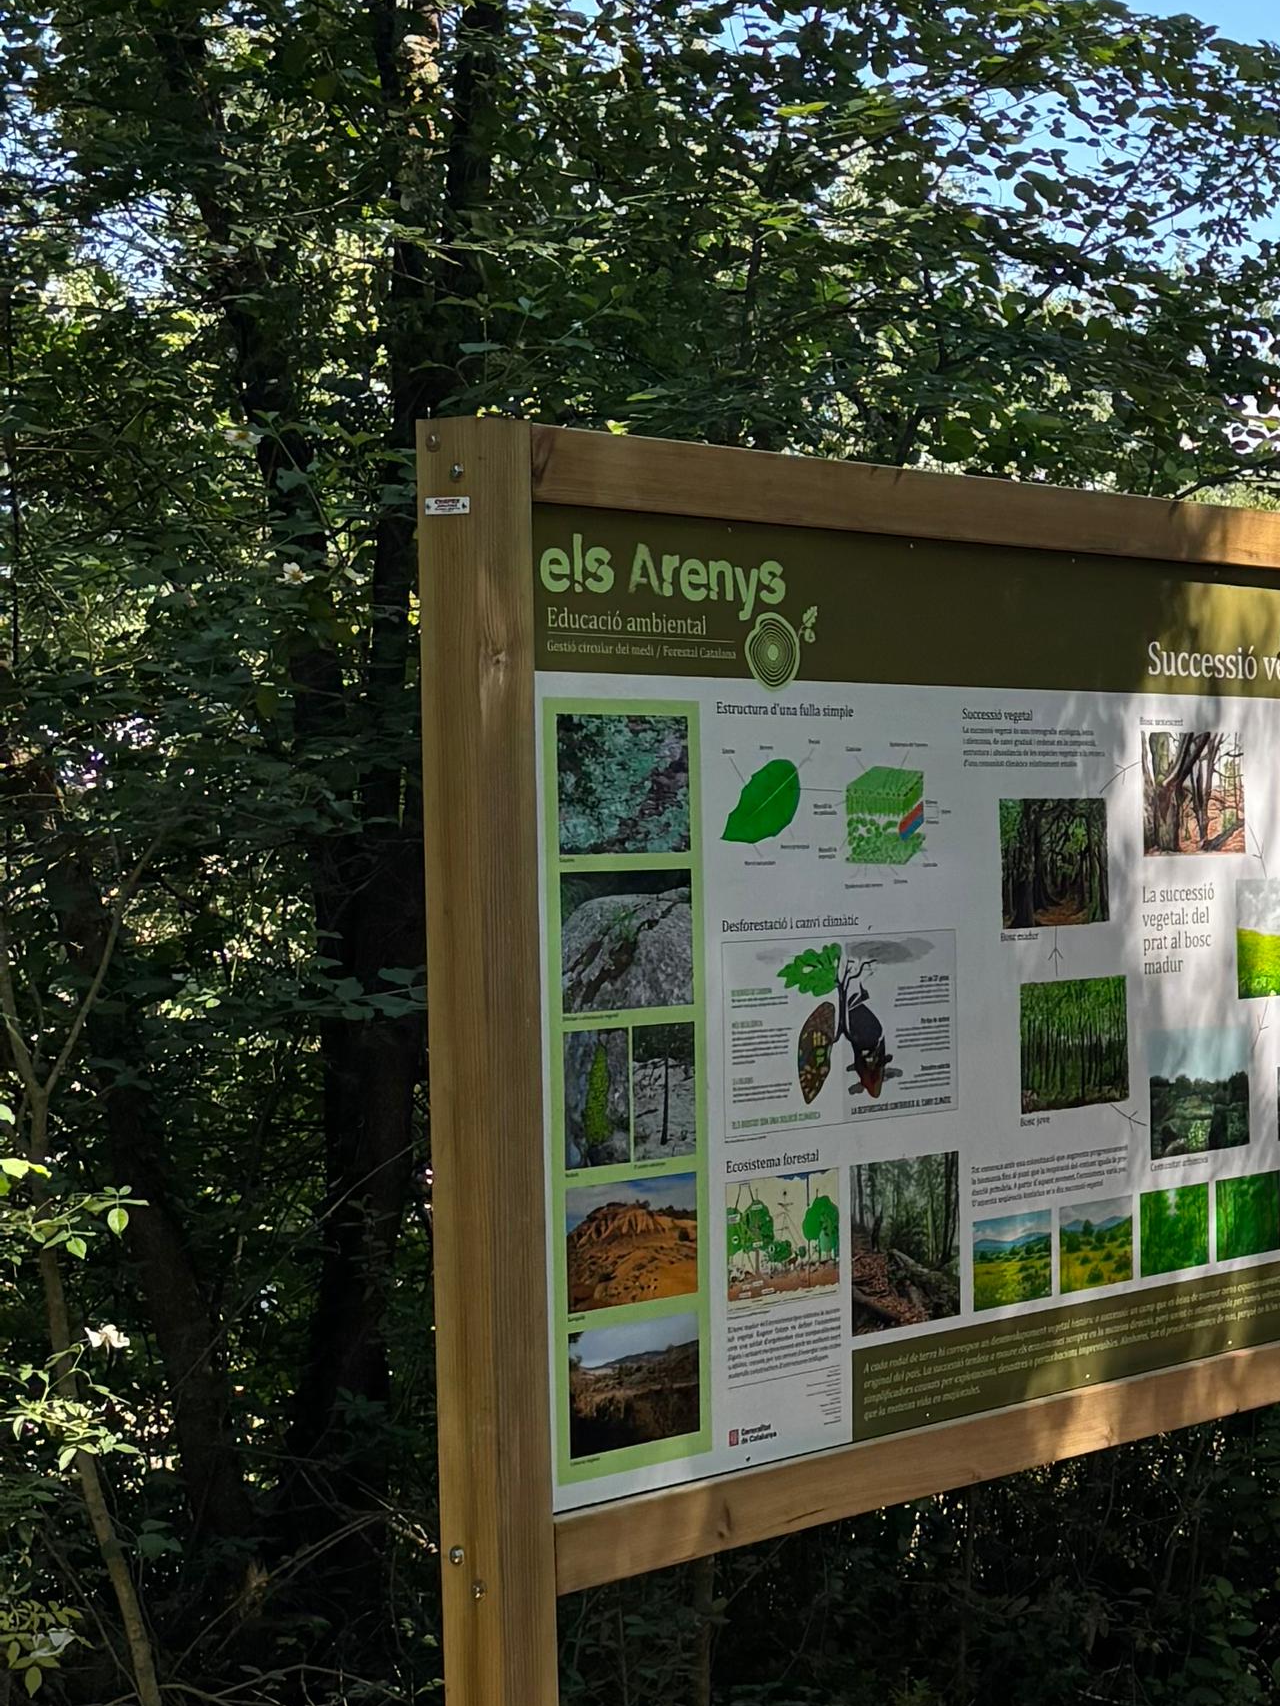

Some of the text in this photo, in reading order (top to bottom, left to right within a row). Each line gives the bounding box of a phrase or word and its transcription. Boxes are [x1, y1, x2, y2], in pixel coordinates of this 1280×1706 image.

[541, 533, 786, 621] els Arenys
[547, 607, 706, 636] Educació ambiental
[547, 640, 577, 652] Gestió
[578, 641, 612, 654] circular
[616, 642, 630, 655] del
[632, 644, 654, 656] medi
[663, 645, 698, 658] Forestal
[700, 646, 737, 659] Catalana
[1148, 641, 1258, 680] Successió
[716, 701, 854, 720] Estructura d'una fulla simple
[962, 708, 1033, 723] Successió vegetal
[1143, 883, 1215, 903] La successió
[722, 917, 788, 933] Desforestació
[795, 918, 821, 929] canvi
[822, 915, 859, 928] climàtic
[1143, 906, 1210, 931] vegetal: del
[1143, 930, 1211, 956] prat al bosc
[1144, 956, 1183, 975] madur
[726, 1149, 819, 1174] Ecosistema forestal
